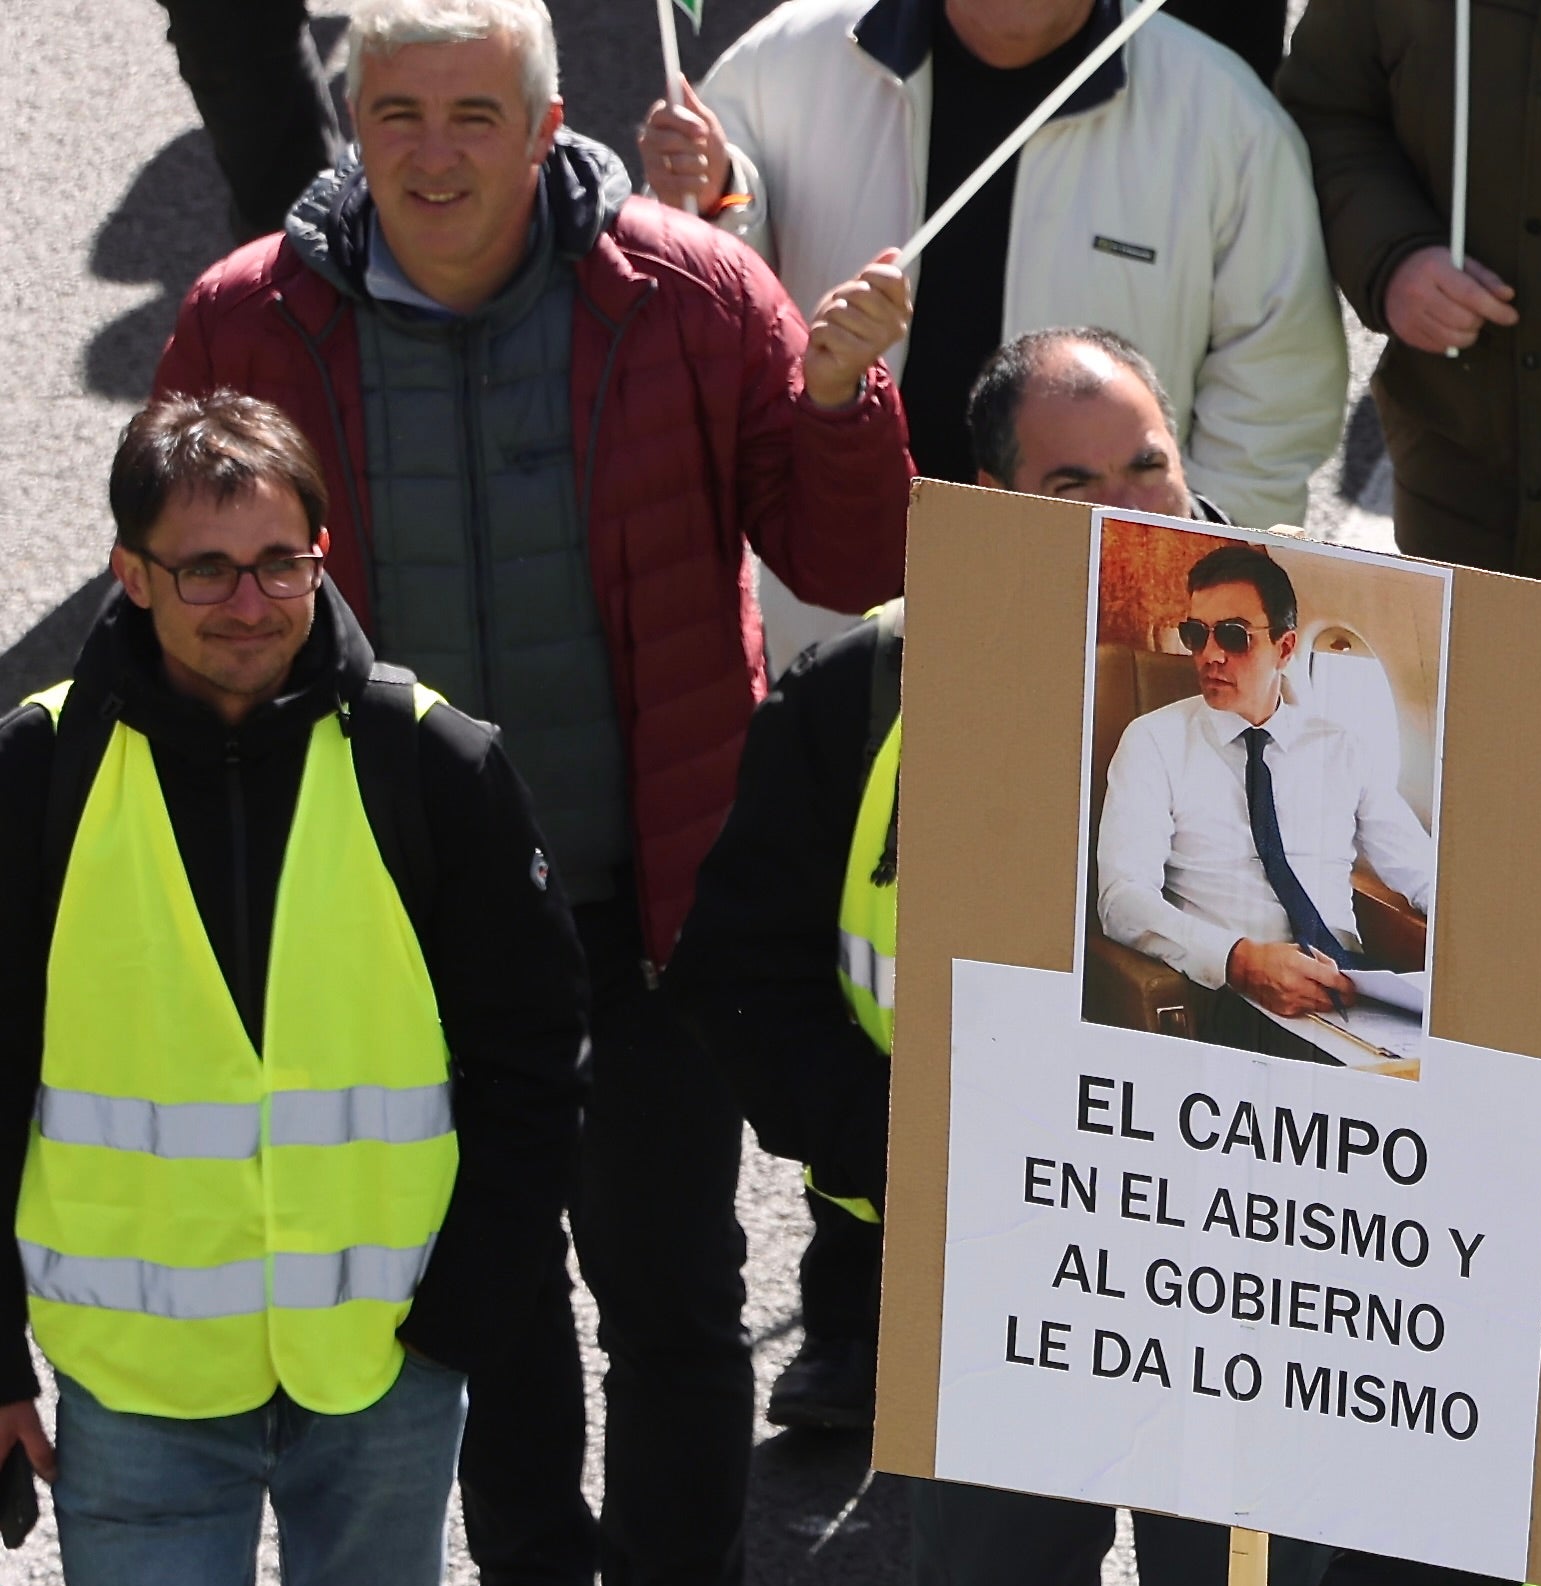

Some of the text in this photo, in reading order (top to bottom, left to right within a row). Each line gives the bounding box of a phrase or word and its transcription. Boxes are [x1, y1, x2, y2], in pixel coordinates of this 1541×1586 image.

[1077, 1074, 1428, 1186] EL CAMPO
[1024, 1156, 1486, 1279] EN EL ABISMO Y
[1051, 1243, 1445, 1352] AL GOBIERNO
[1005, 1314, 1479, 1441] LE DA LO MISMO
